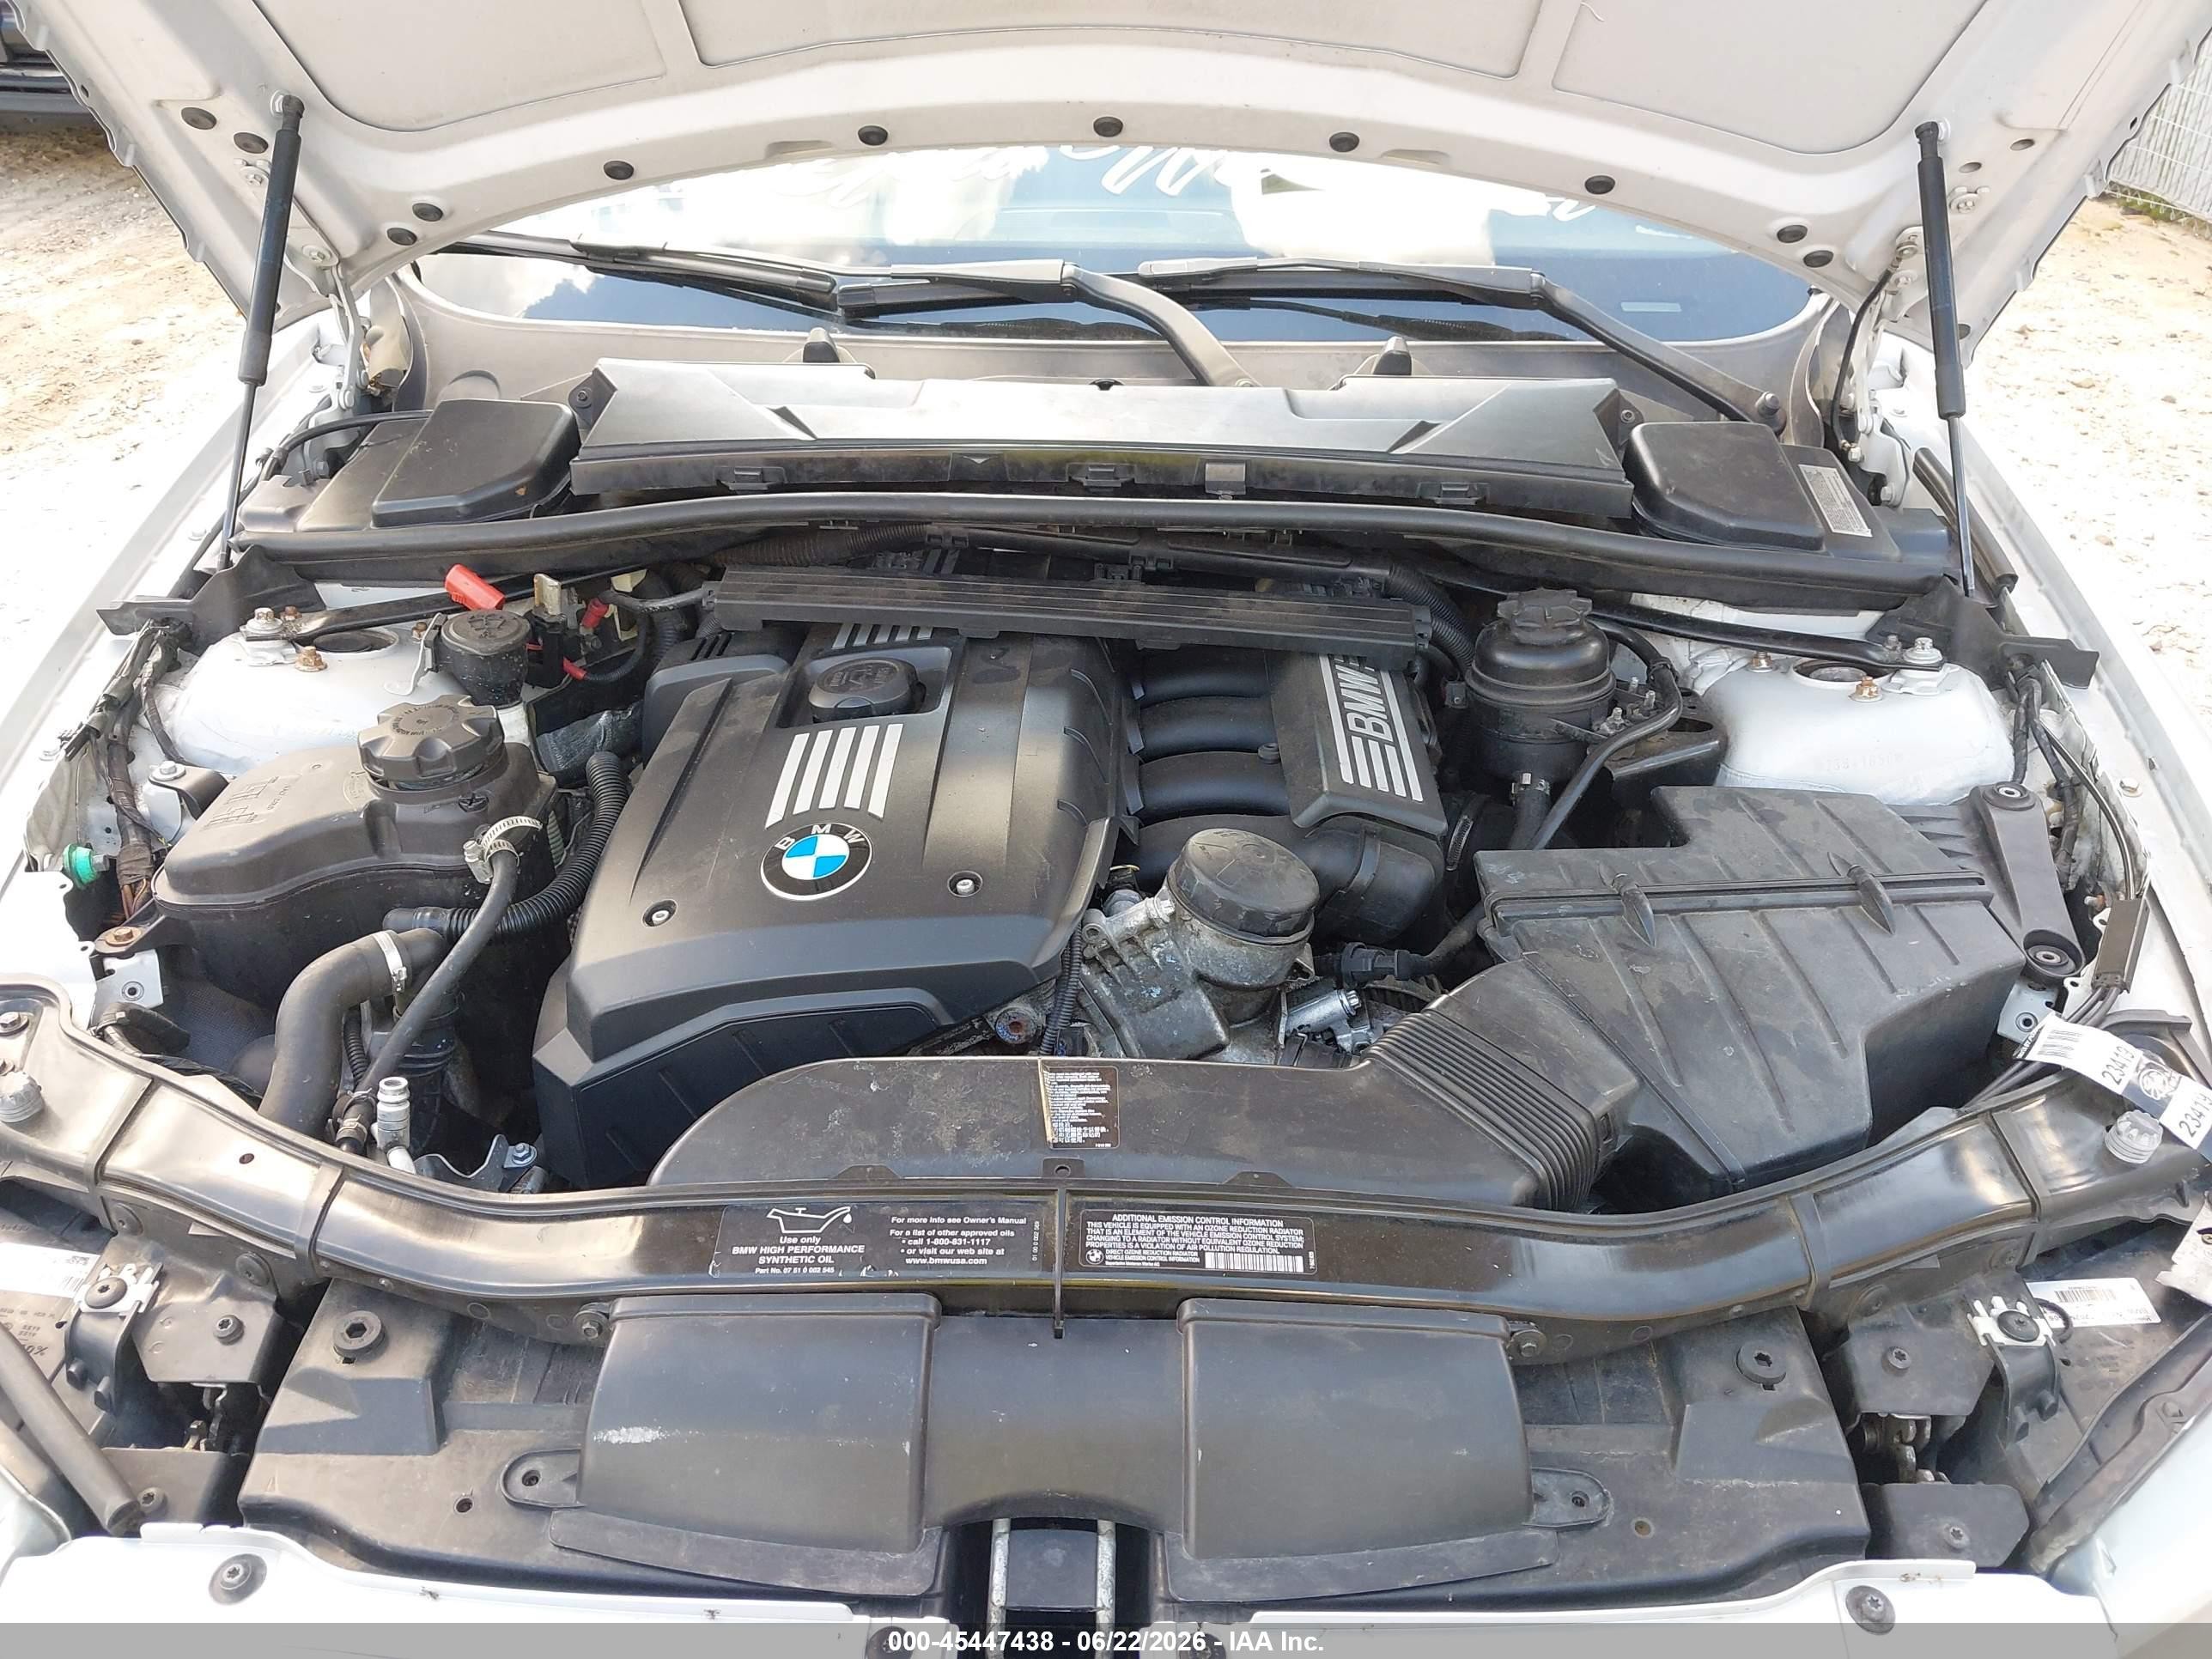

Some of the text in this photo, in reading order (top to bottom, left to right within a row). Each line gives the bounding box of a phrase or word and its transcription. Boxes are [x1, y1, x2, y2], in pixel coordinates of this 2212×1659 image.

[1335, 665, 1393, 742] BMW
[775, 824, 866, 850] BMW
[1195, 1217, 1230, 1225] CONTROL
[1231, 1218, 1284, 1227] INFORMATION
[800, 1237, 821, 1245] only
[1275, 1235, 1304, 1243] SYSTEM;
[787, 1245, 865, 1254] PERFORMANCE
[1237, 1246, 1280, 1255] REGULATION.
[759, 1255, 815, 1264] SYNTHETIC
